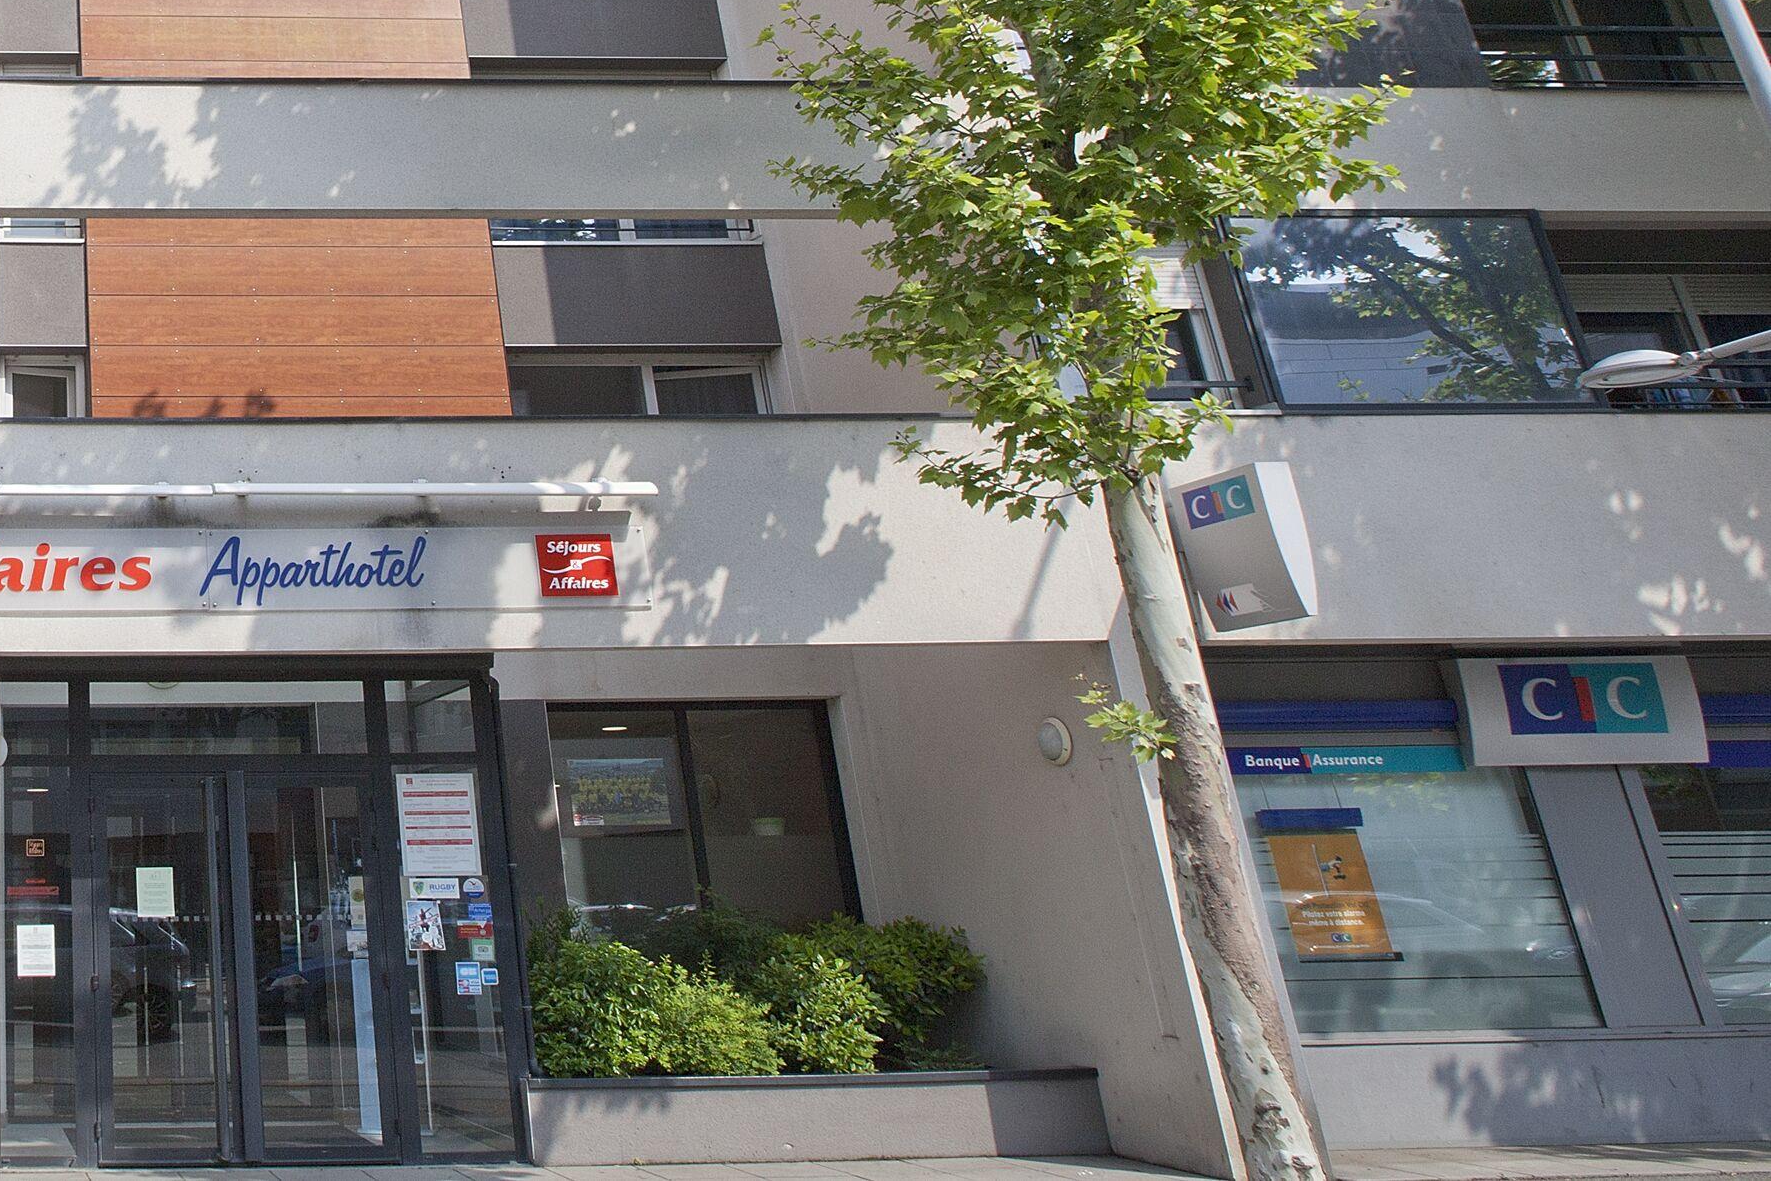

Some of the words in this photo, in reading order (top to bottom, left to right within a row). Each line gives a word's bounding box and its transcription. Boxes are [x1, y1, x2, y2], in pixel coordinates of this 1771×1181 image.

[1191, 485, 1246, 519] CIC
[547, 541, 602, 556] Séjours
[199, 536, 426, 606] Apparthotel
[549, 576, 610, 589] Affaires
[1522, 676, 1648, 723] CIC
[1244, 754, 1300, 770] Banque
[1313, 754, 1384, 767] Assurance
[429, 883, 456, 891] RUGBY
